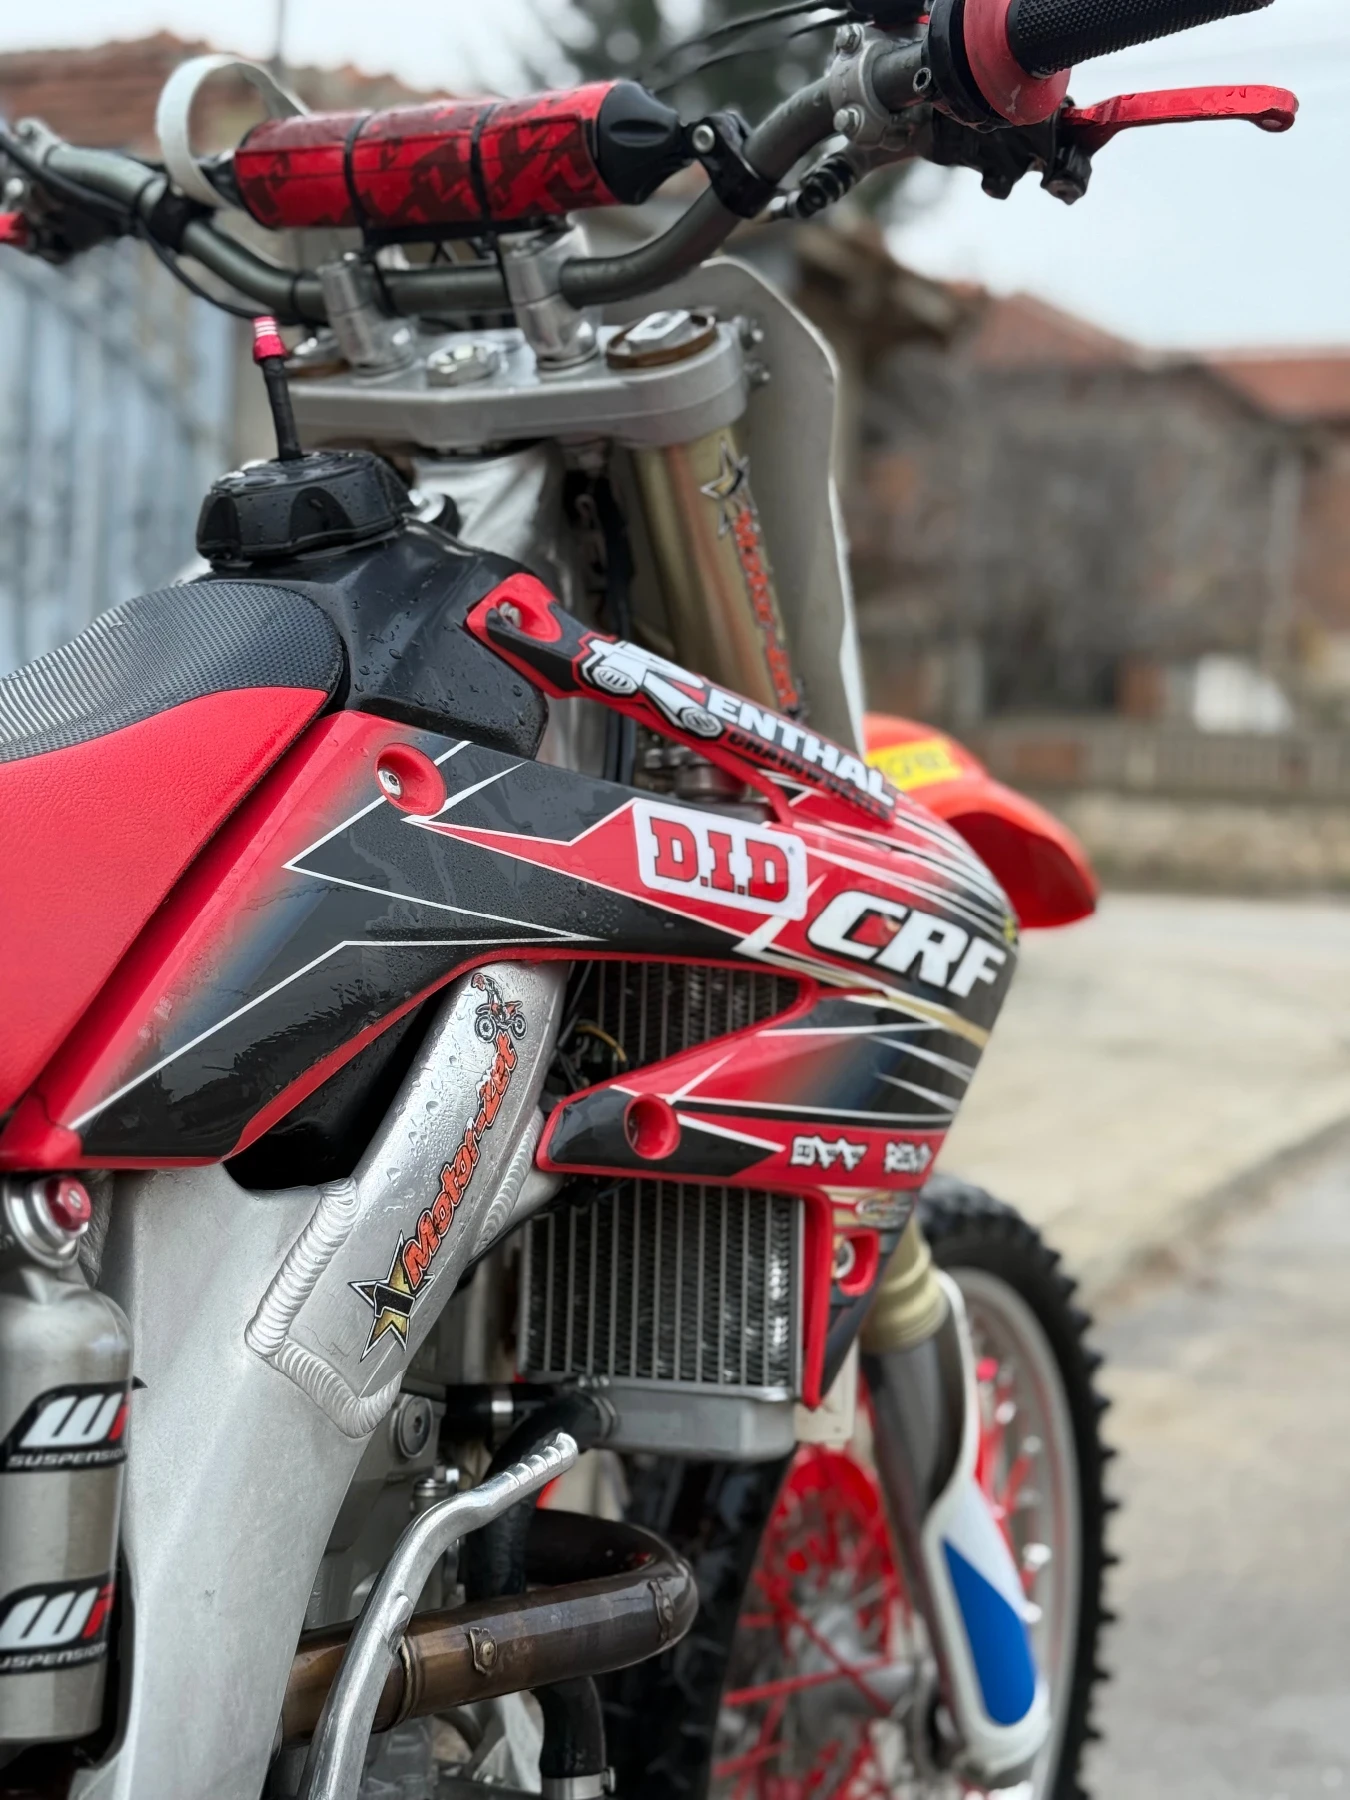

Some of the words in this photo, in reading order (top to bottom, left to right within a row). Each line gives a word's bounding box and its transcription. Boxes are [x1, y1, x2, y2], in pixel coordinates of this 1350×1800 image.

[649, 815, 790, 903] D.I.D
[805, 890, 1007, 998] CRF
[0, 1641, 107, 1670] USPENSION
